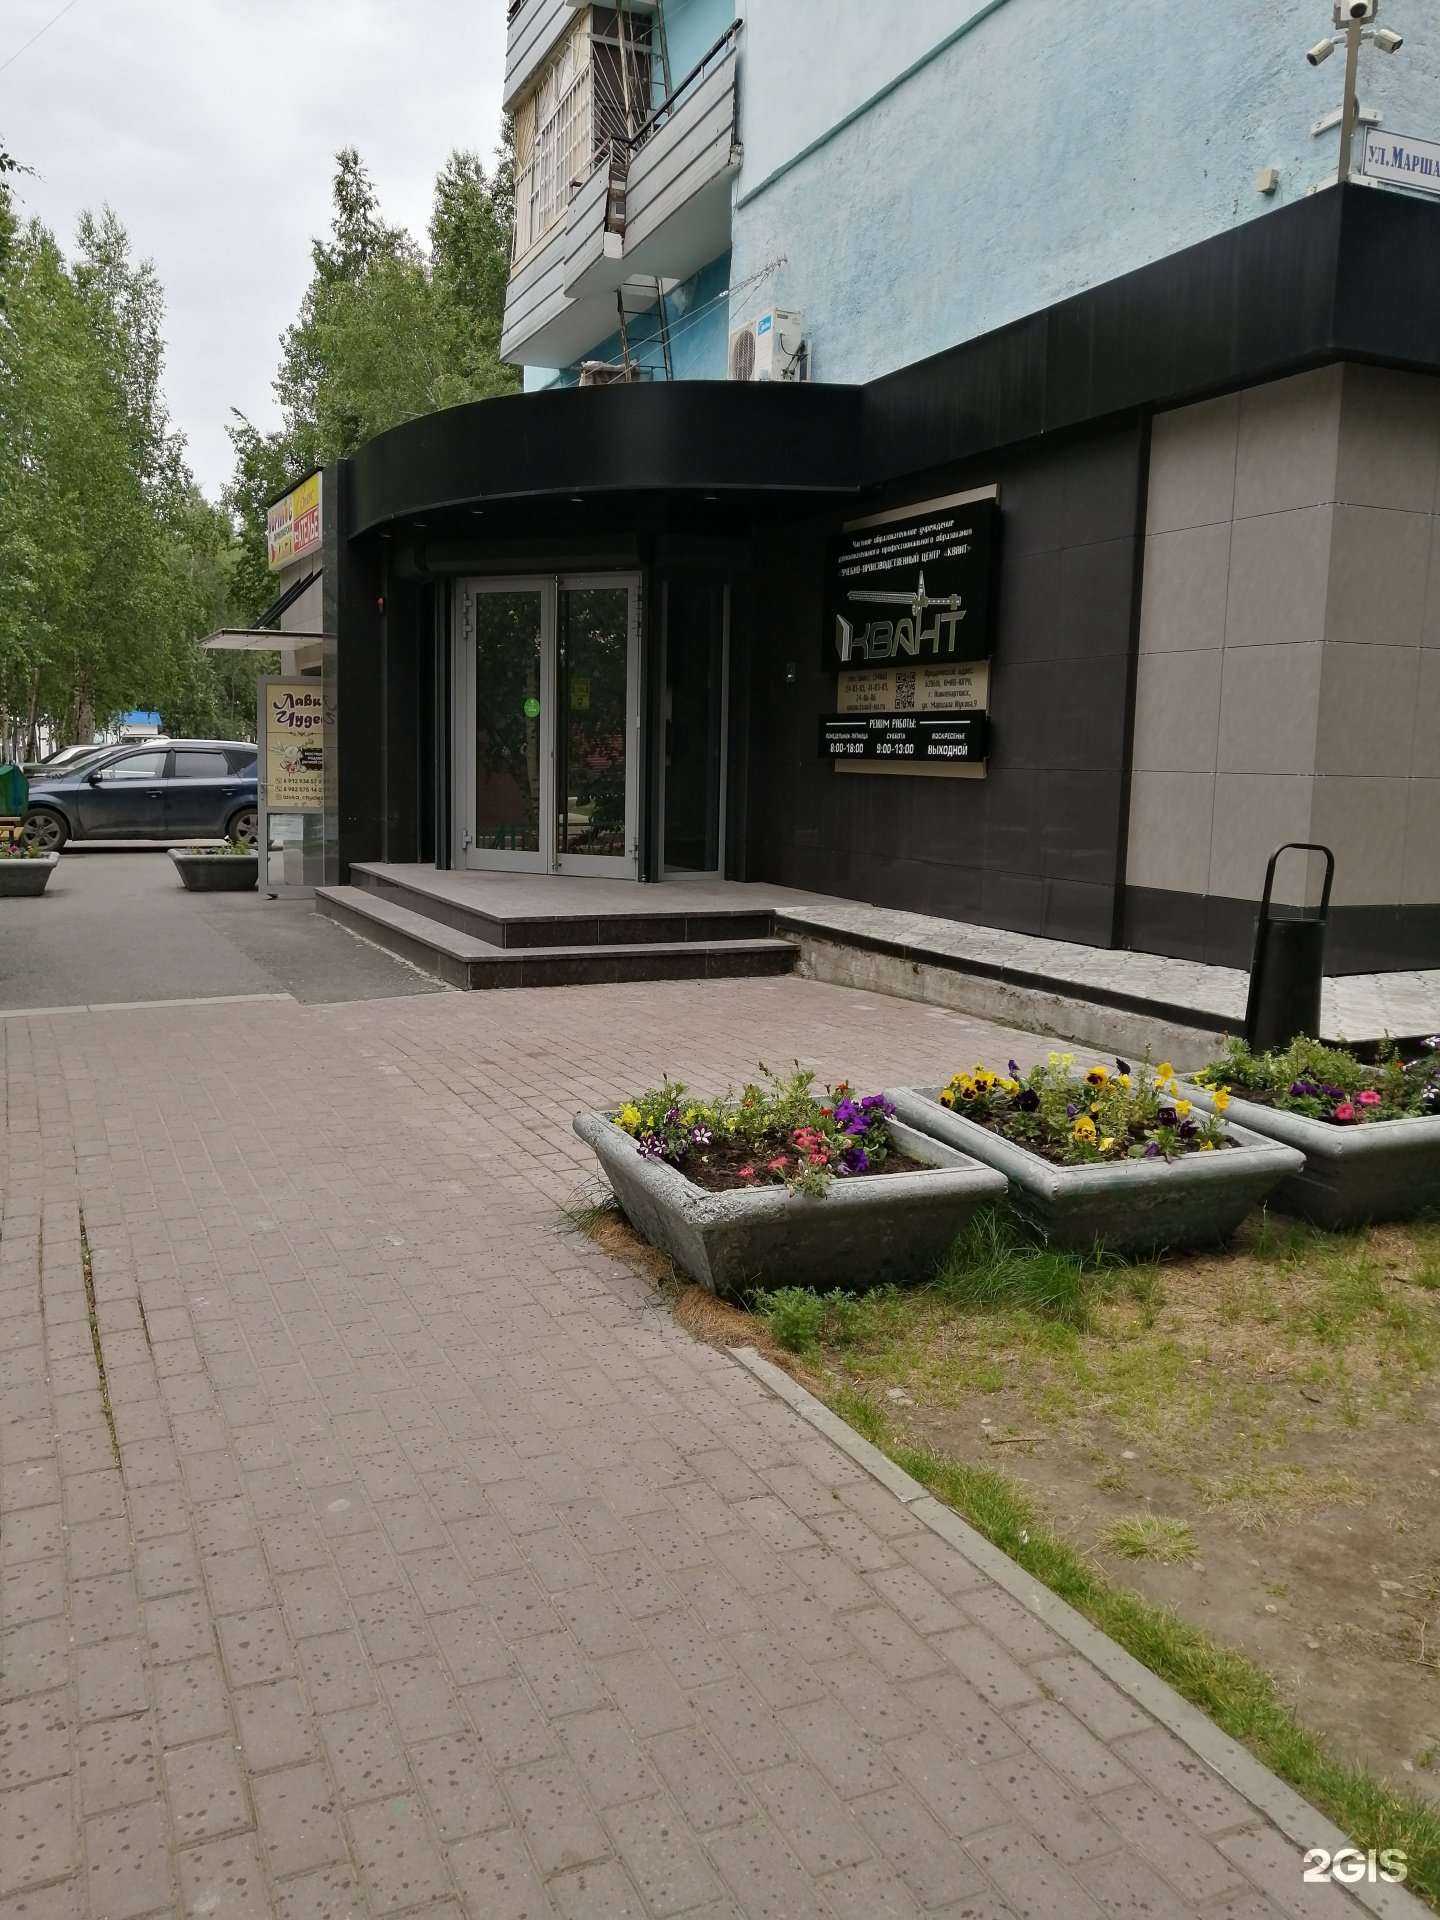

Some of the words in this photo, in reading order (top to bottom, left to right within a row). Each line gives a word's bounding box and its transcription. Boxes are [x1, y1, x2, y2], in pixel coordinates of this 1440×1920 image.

[921, 549, 941, 562] ЦЕНТР
[869, 719, 890, 729] РЕЖИМ
[891, 718, 917, 729] РАБОТЫ:
[830, 743, 864, 754] 8:00-18:00
[876, 743, 914, 755] 9:00-13:00
[928, 743, 968, 757] ВЫХОДНОЙ
